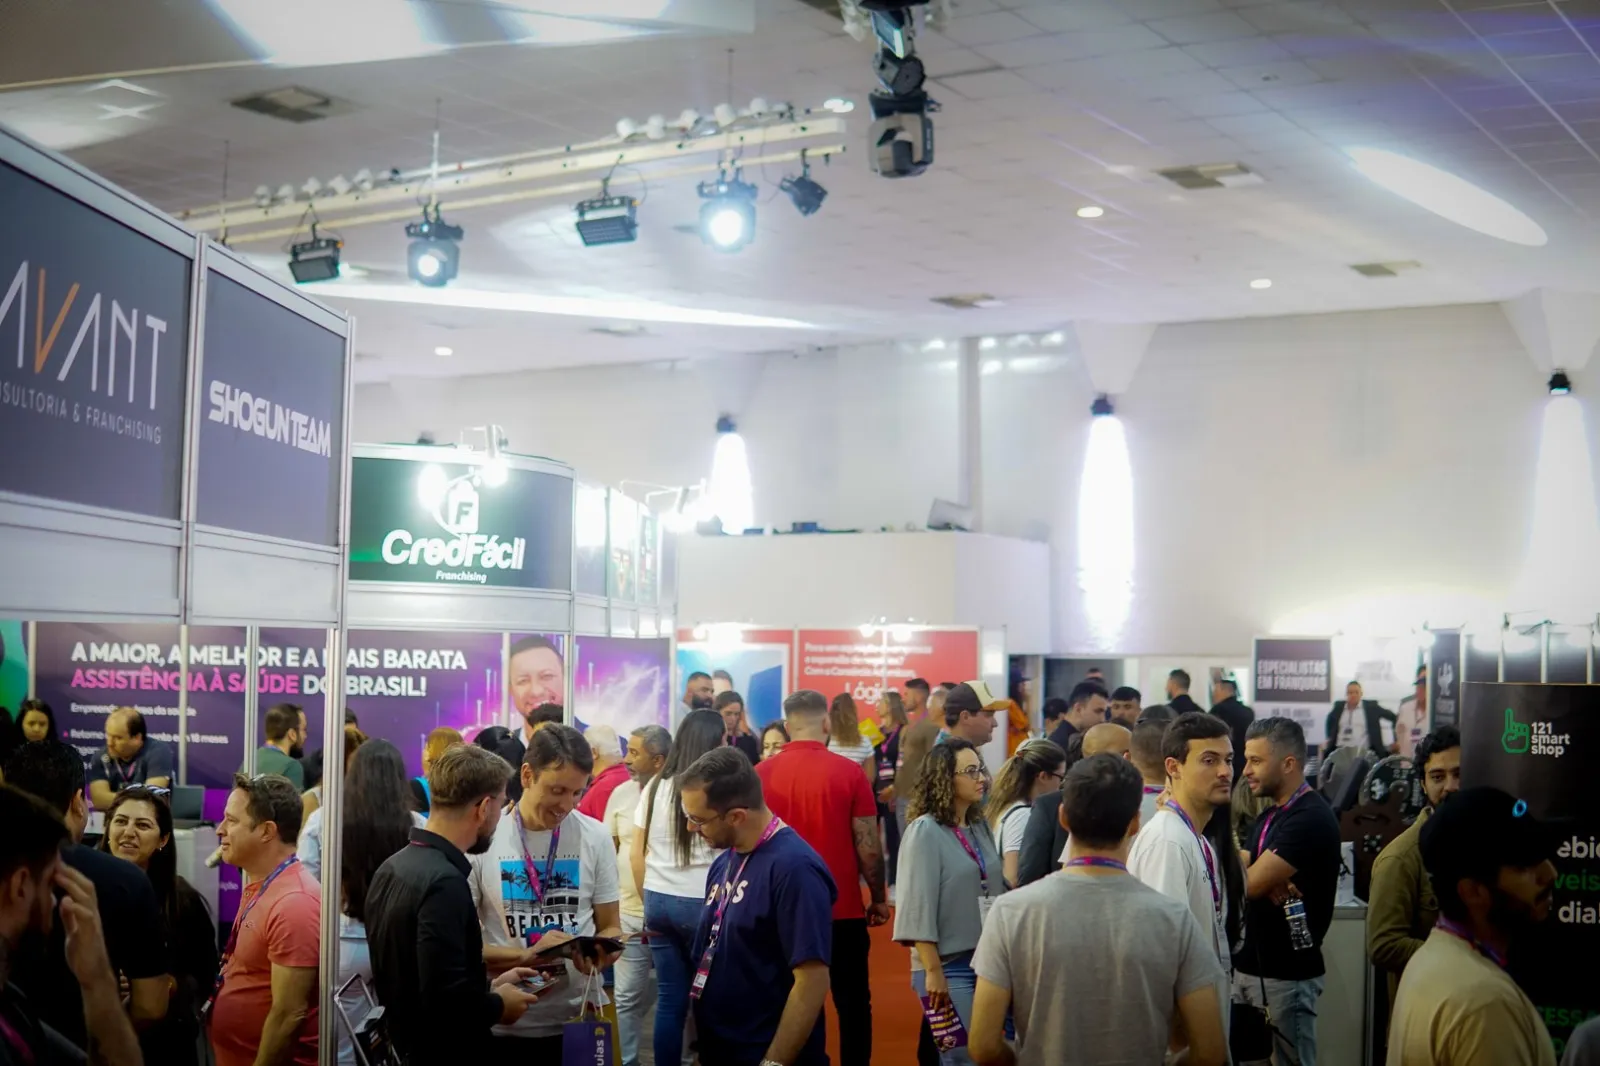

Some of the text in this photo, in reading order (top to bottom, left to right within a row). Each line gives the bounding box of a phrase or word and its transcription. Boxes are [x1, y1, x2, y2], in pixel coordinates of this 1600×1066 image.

[0, 260, 167, 411] AVANT
[0, 381, 162, 444] SULTORIA & FRANCHISING
[436, 570, 487, 583] Franchising
[71, 642, 88, 661] A
[90, 642, 165, 667] MAIOR,
[188, 645, 282, 667] MELHOR
[286, 646, 300, 667] E
[302, 648, 319, 667] A
[323, 648, 379, 669] AIS
[383, 648, 468, 670] BARATA
[71, 666, 207, 692] ASSISTÊNCIA
[209, 666, 225, 692] À
[228, 667, 299, 693] SÚDE
[346, 674, 427, 697] BRASIL!
[1531, 722, 1552, 734] 121
[1531, 733, 1570, 745] smart
[1531, 744, 1564, 758] shop
